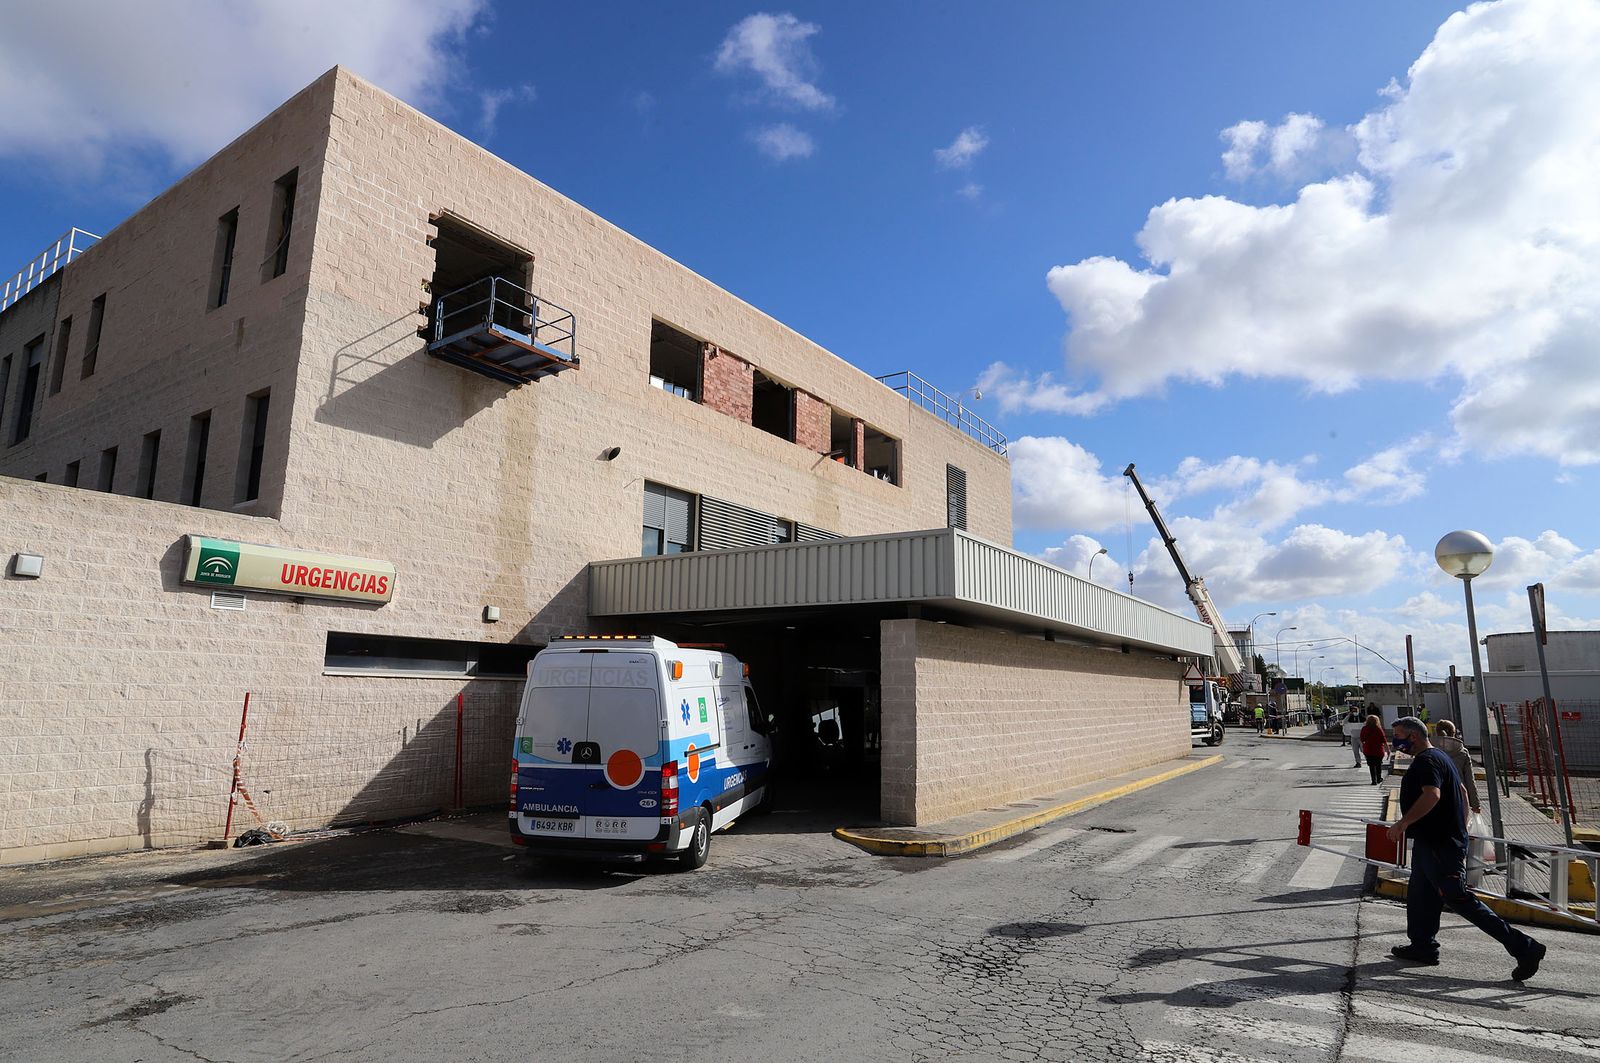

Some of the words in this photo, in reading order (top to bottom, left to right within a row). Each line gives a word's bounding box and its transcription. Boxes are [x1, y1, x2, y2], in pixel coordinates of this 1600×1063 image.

[280, 563, 388, 595] URGENCIAS
[540, 669, 649, 686] URGENCIAS
[522, 802, 579, 813] AMBULANCIA
[536, 821, 556, 830] 6492
[557, 822, 573, 831] KBR
